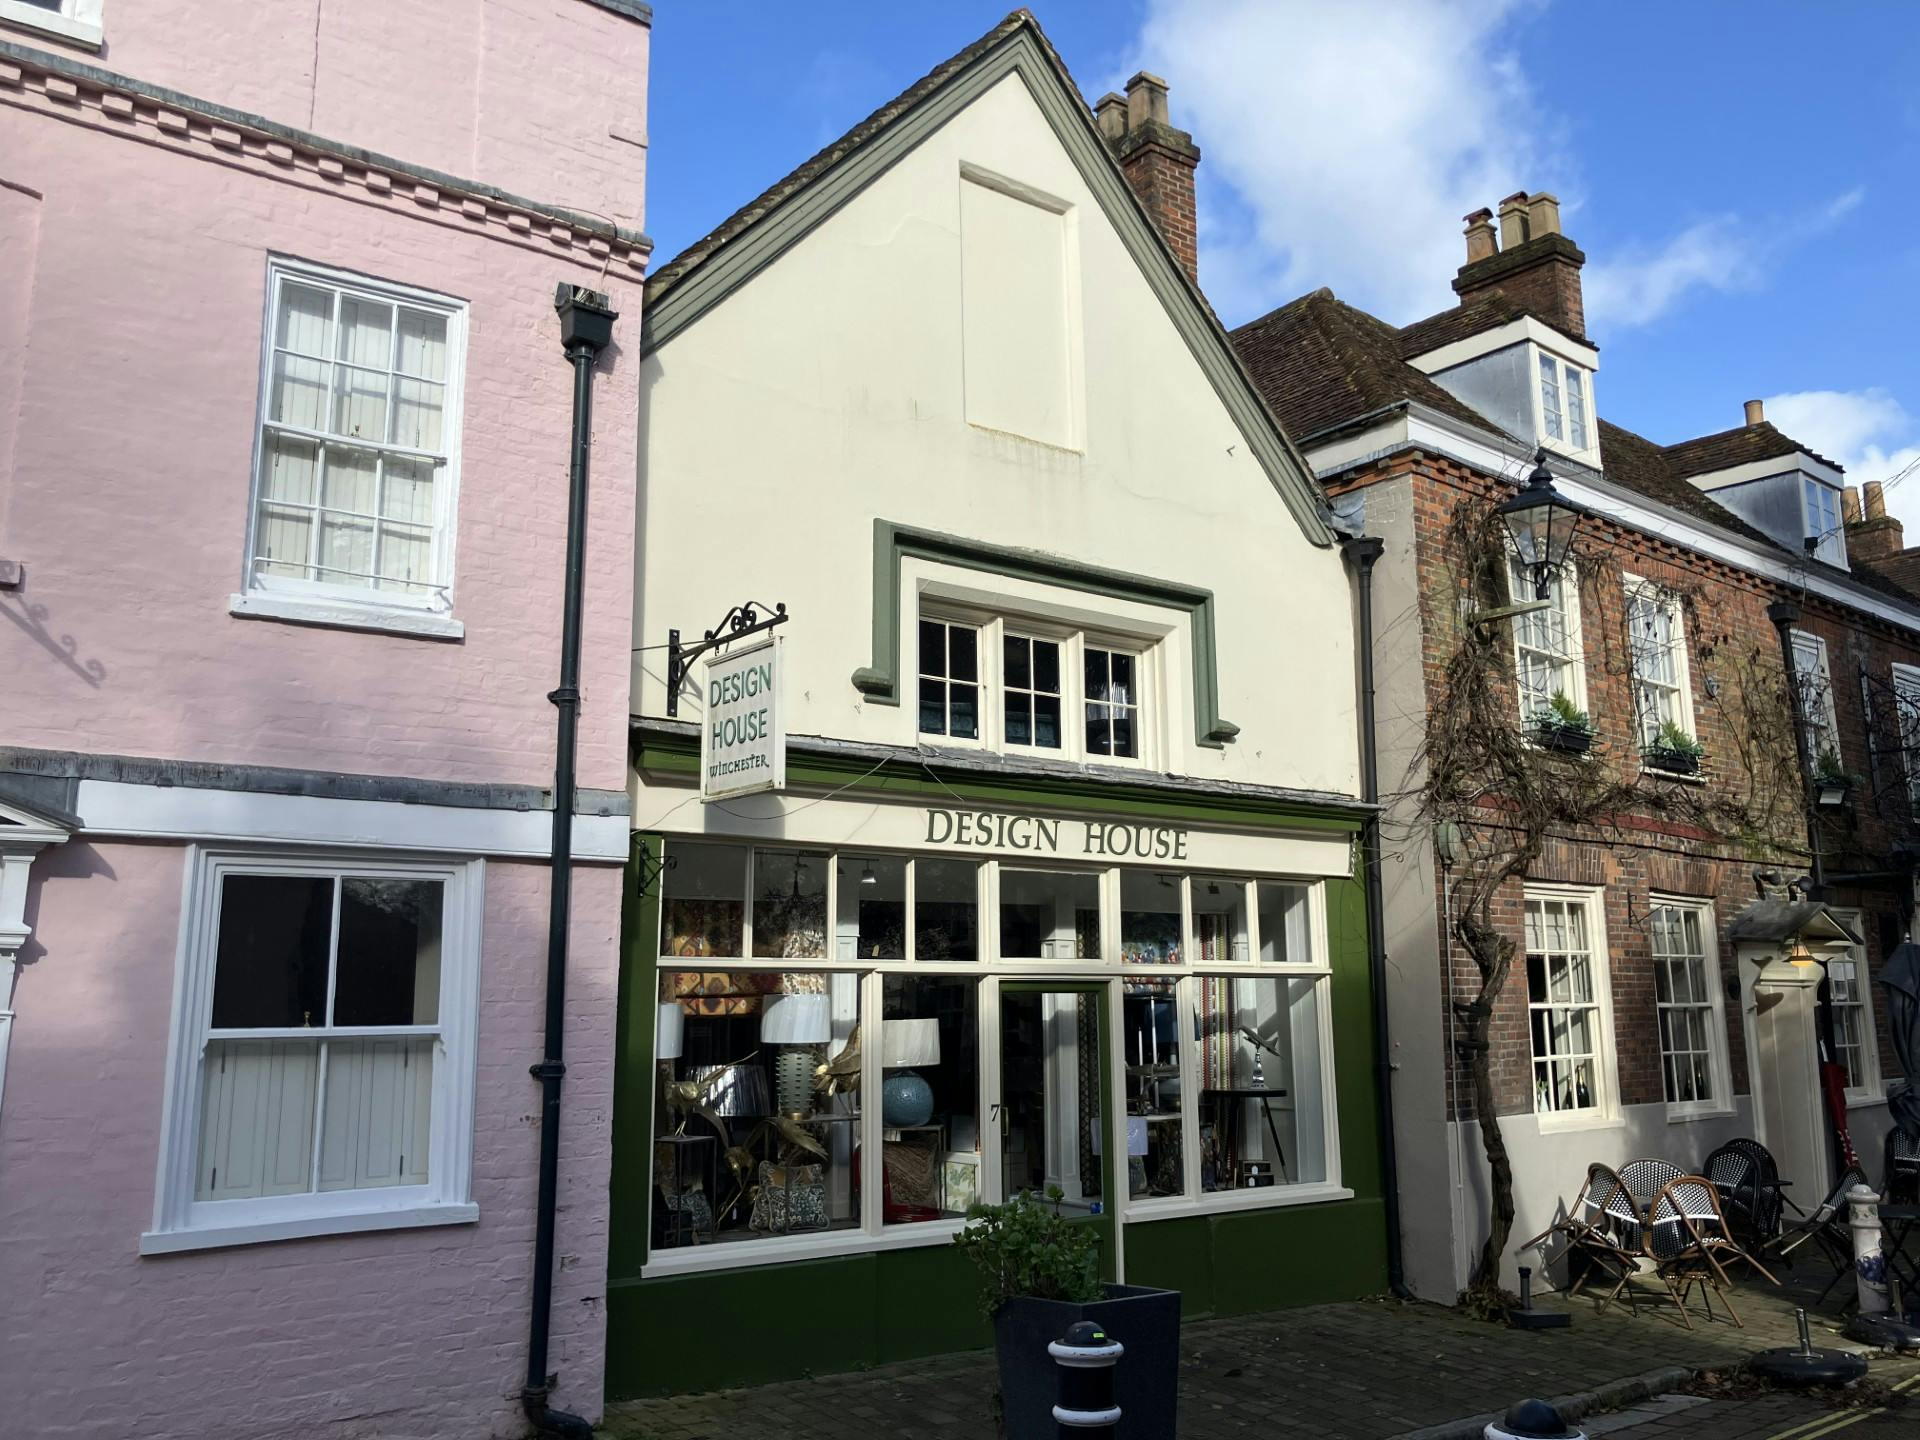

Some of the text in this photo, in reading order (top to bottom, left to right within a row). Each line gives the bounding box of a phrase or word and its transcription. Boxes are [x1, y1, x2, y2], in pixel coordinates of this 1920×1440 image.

[711, 663, 771, 708] DESIGN
[712, 708, 768, 750] HOUSE
[924, 809, 1188, 861] DESIGN HOUSE
[990, 1103, 1001, 1122] 7
